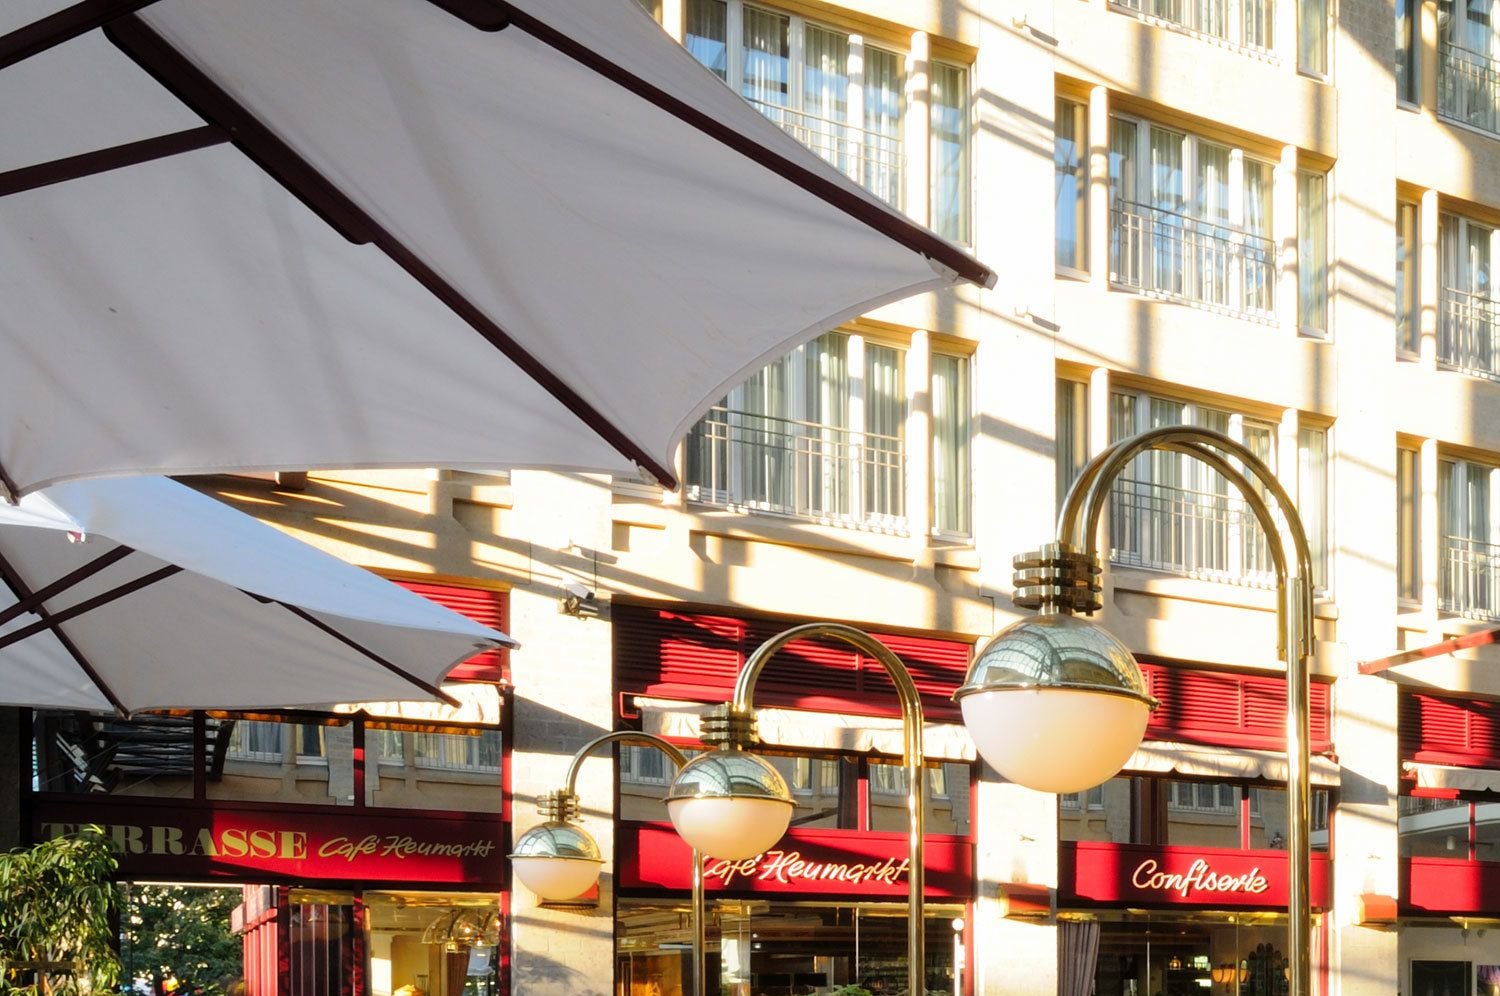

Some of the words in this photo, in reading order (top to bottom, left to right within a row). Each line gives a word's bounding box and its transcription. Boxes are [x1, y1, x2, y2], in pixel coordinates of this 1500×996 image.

[41, 822, 308, 859] TRRASSE
[318, 835, 380, 862] Café
[381, 836, 495, 859] Heumarkt
[758, 850, 910, 885] Heumarkt
[1132, 859, 1269, 897] Confiserie
